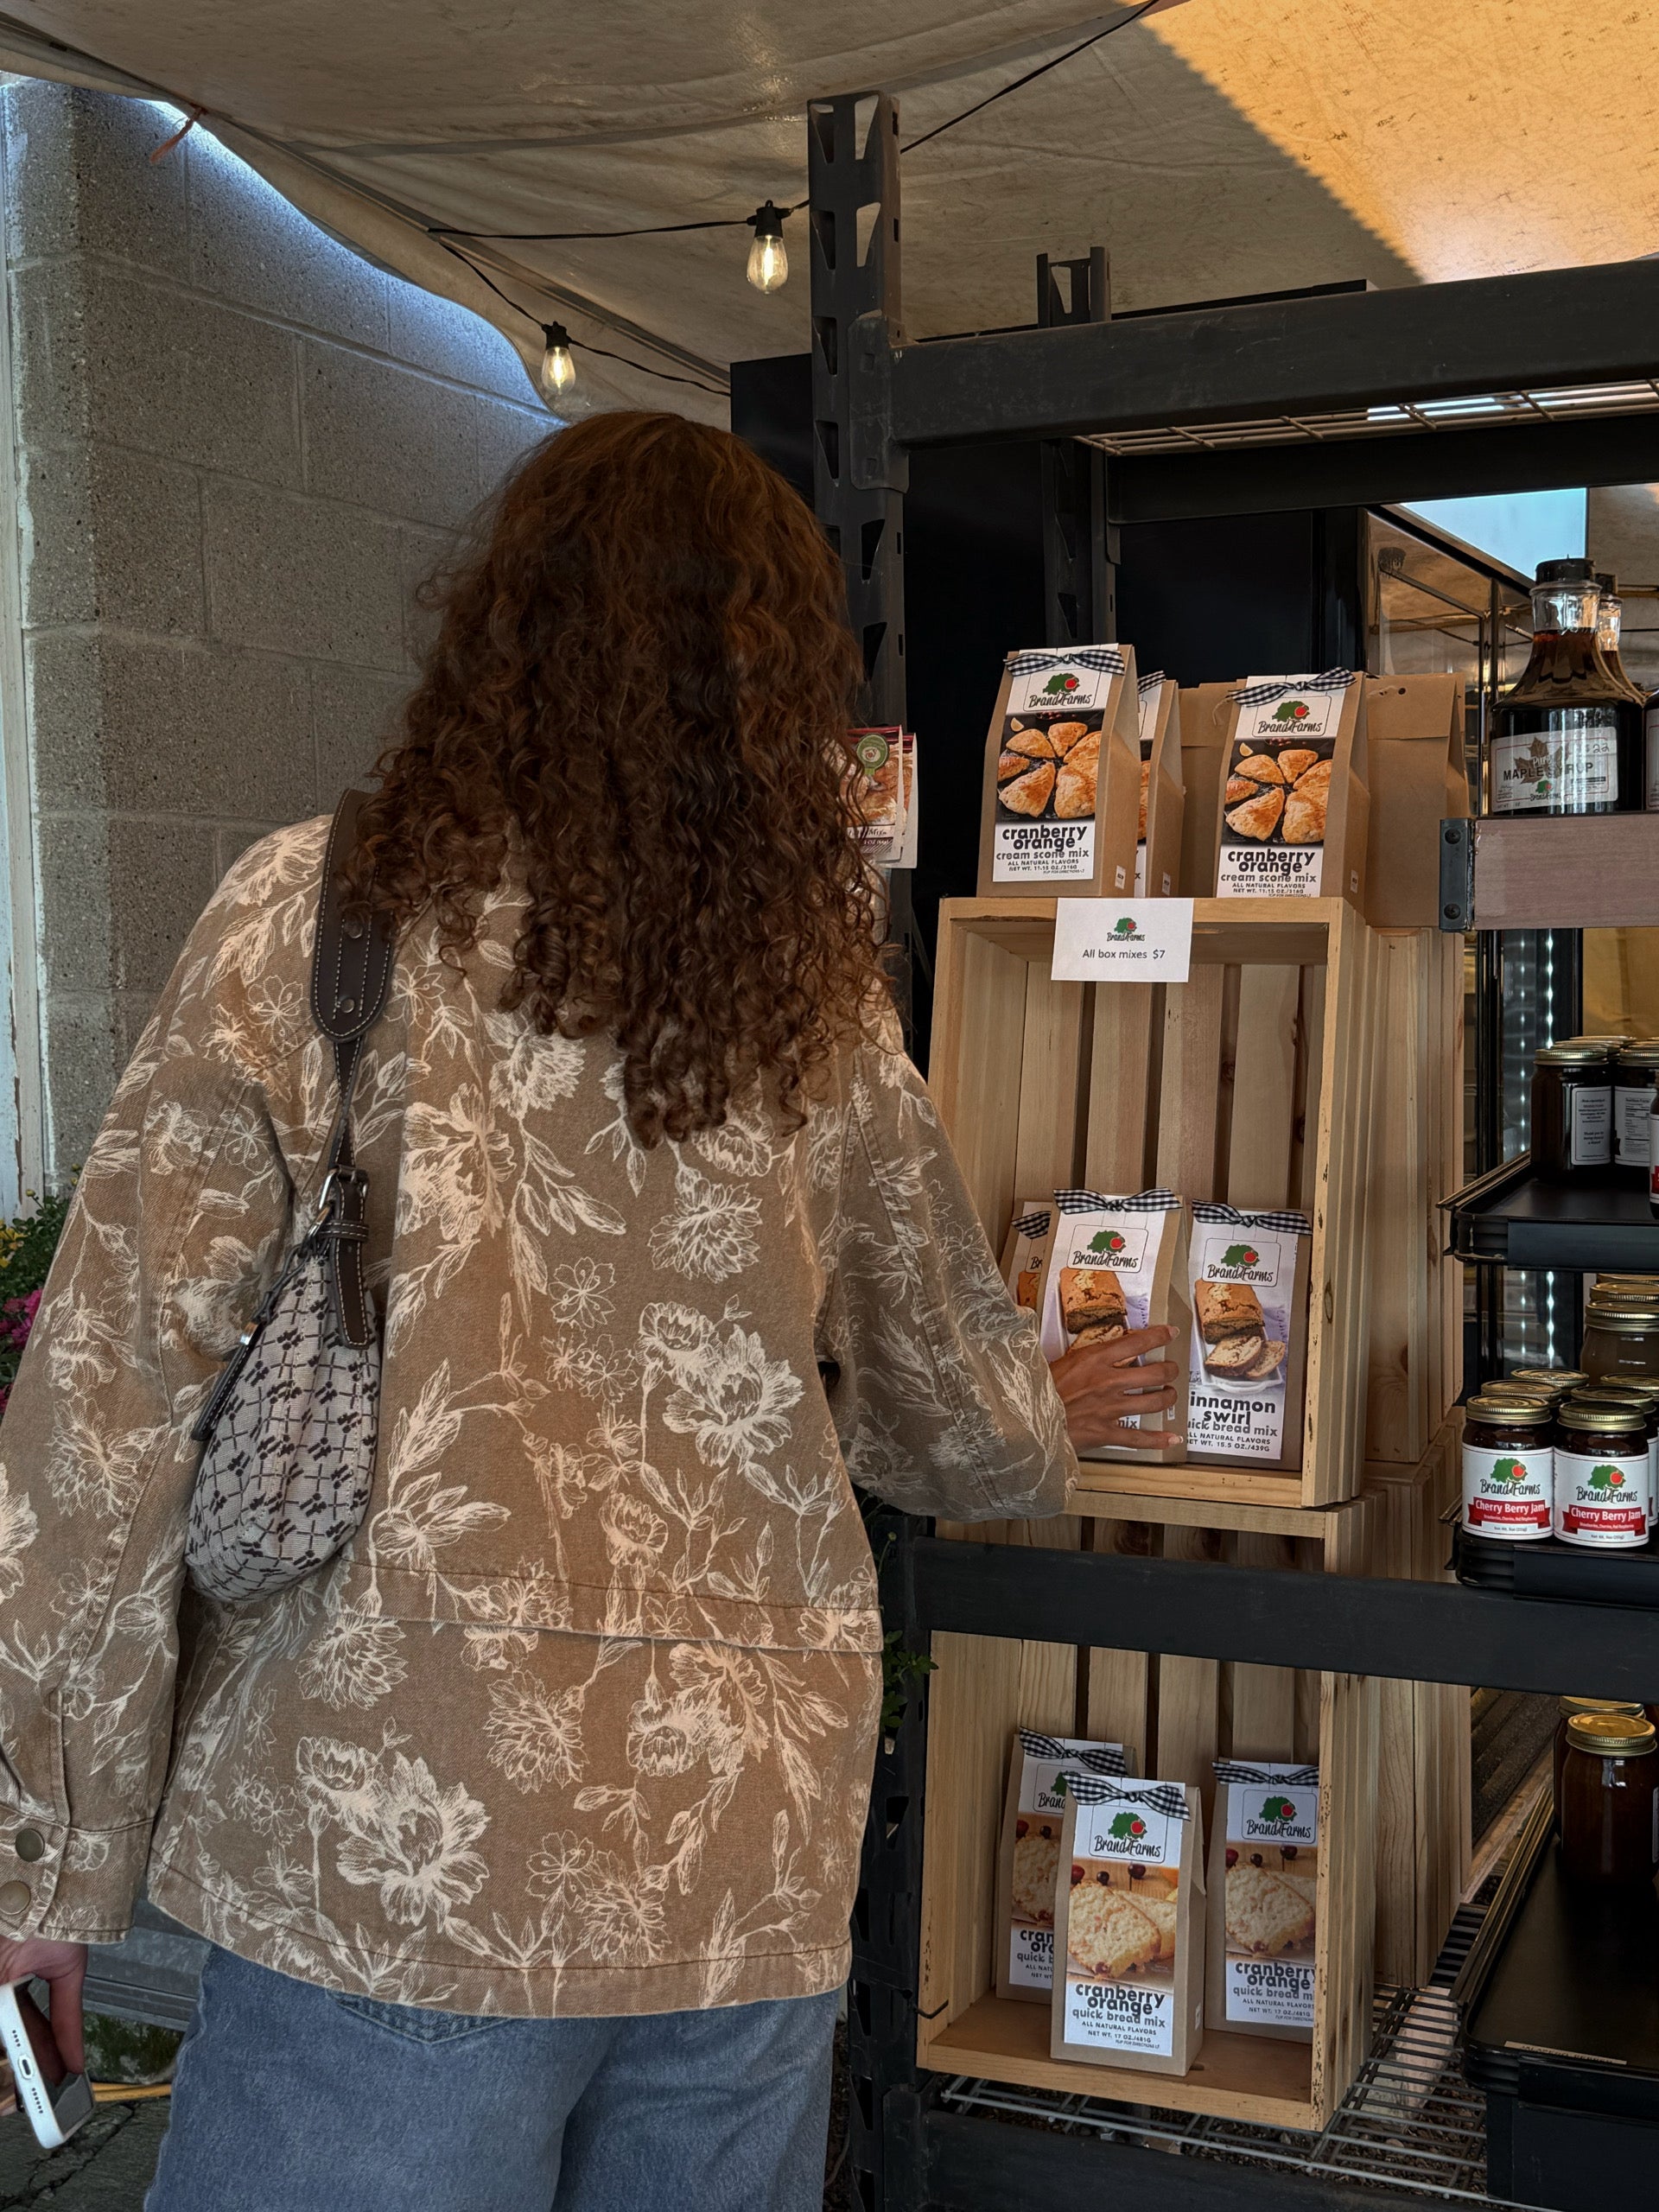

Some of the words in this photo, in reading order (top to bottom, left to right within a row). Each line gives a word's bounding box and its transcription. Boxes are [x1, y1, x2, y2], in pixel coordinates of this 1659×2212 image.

[1503, 767, 1544, 781] MAPLE
[1002, 824, 1087, 841] cranberry
[1014, 837, 1076, 852] orange
[1069, 848, 1089, 857] mix
[1228, 849, 1315, 866] cranberry
[1239, 861, 1302, 876] orange
[1295, 873, 1317, 883] mix
[1082, 950, 1095, 958] All
[1098, 950, 1116, 959] box
[1119, 950, 1147, 959] mixes
[1153, 949, 1166, 960] $7
[1072, 1249, 1105, 1266] Brand
[1107, 1253, 1139, 1268] Farms
[1207, 1263, 1240, 1279] Brand
[1242, 1267, 1274, 1282] Farms
[1190, 1391, 1275, 1414] innamon
[1204, 1410, 1250, 1425] swirl
[1187, 1418, 1210, 1430] ick
[1213, 1421, 1250, 1434] bread
[1254, 1425, 1278, 1437] mix
[1200, 1433, 1234, 1441] NATURAL
[1237, 1436, 1271, 1445] FLAVORS
[1480, 1478, 1510, 1495] Brand
[1513, 1482, 1541, 1496] Farms
[1576, 1485, 1608, 1502] Brand
[1610, 1488, 1638, 1503] Farms
[1475, 1499, 1503, 1515] Cherry
[1504, 1503, 1529, 1516] Berry
[1530, 1503, 1545, 1514] Jam
[1571, 1507, 1599, 1522] Cherry
[1602, 1510, 1626, 1522] Berry
[1628, 1510, 1641, 1522] Jam
[1246, 1819, 1277, 1836] Brand
[1281, 1821, 1312, 1839] Farms
[1094, 1834, 1127, 1853] Brand
[1129, 1840, 1161, 1858] Farms
[1017, 1952, 1046, 1962] quick
[1233, 1985, 1262, 1997] quick
[1267, 1987, 1300, 1999] bread
[1247, 1974, 1310, 1993] orange
[1076, 1983, 1165, 2009] cranberry
[1087, 1997, 1153, 2018] orange
[1072, 2007, 1103, 2019] quick
[1107, 2011, 1141, 2024] bread
[1145, 2016, 1166, 2028] mix
[1096, 2023, 1126, 2031] NATURAL
[1128, 2026, 1157, 2036] FLAVORS
